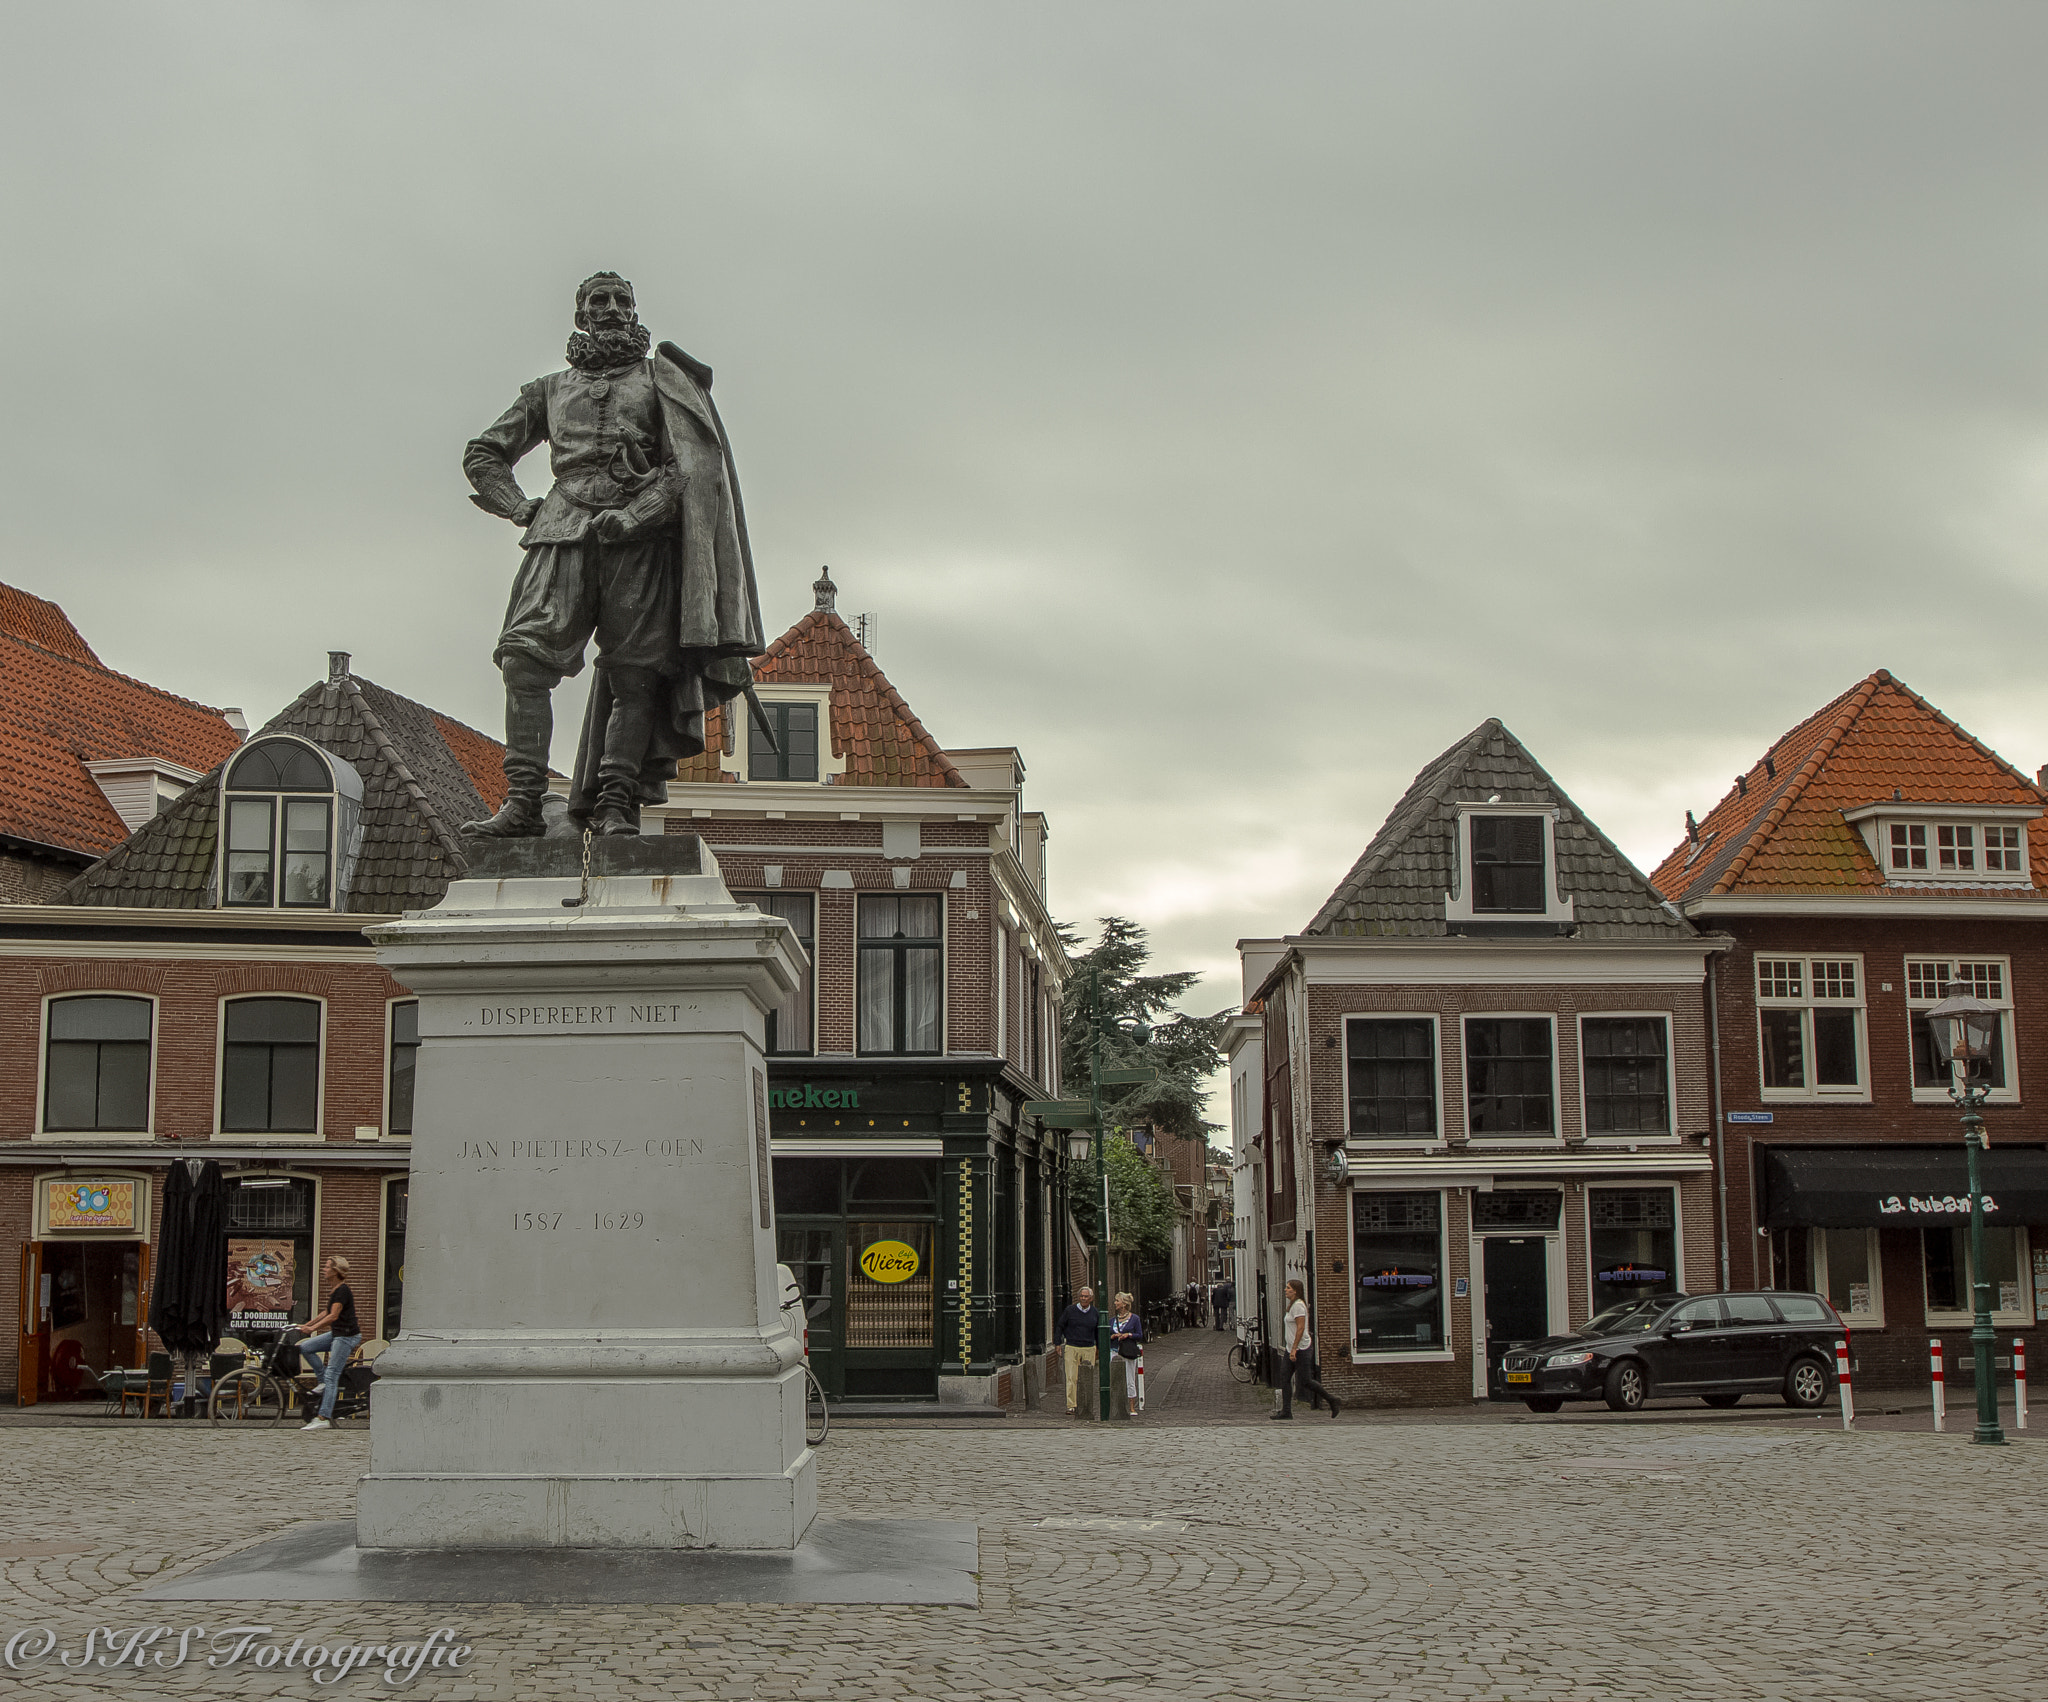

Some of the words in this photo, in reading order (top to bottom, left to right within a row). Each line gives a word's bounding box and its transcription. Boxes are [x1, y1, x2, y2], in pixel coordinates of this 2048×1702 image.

[456, 1141, 499, 1159] JAN
[511, 1139, 625, 1158] PIETERSZ
[645, 1138, 704, 1157] COEN
[1909, 1193, 1999, 1213] Cubana
[513, 1212, 563, 1231] 1587
[594, 1211, 644, 1230] 1629
[863, 1252, 916, 1273] Vièra
[897, 1249, 914, 1259] Café
[230, 1320, 250, 1328] GAAT
[232, 1311, 242, 1320] DE
[244, 1312, 288, 1320] DOORBRAAK
